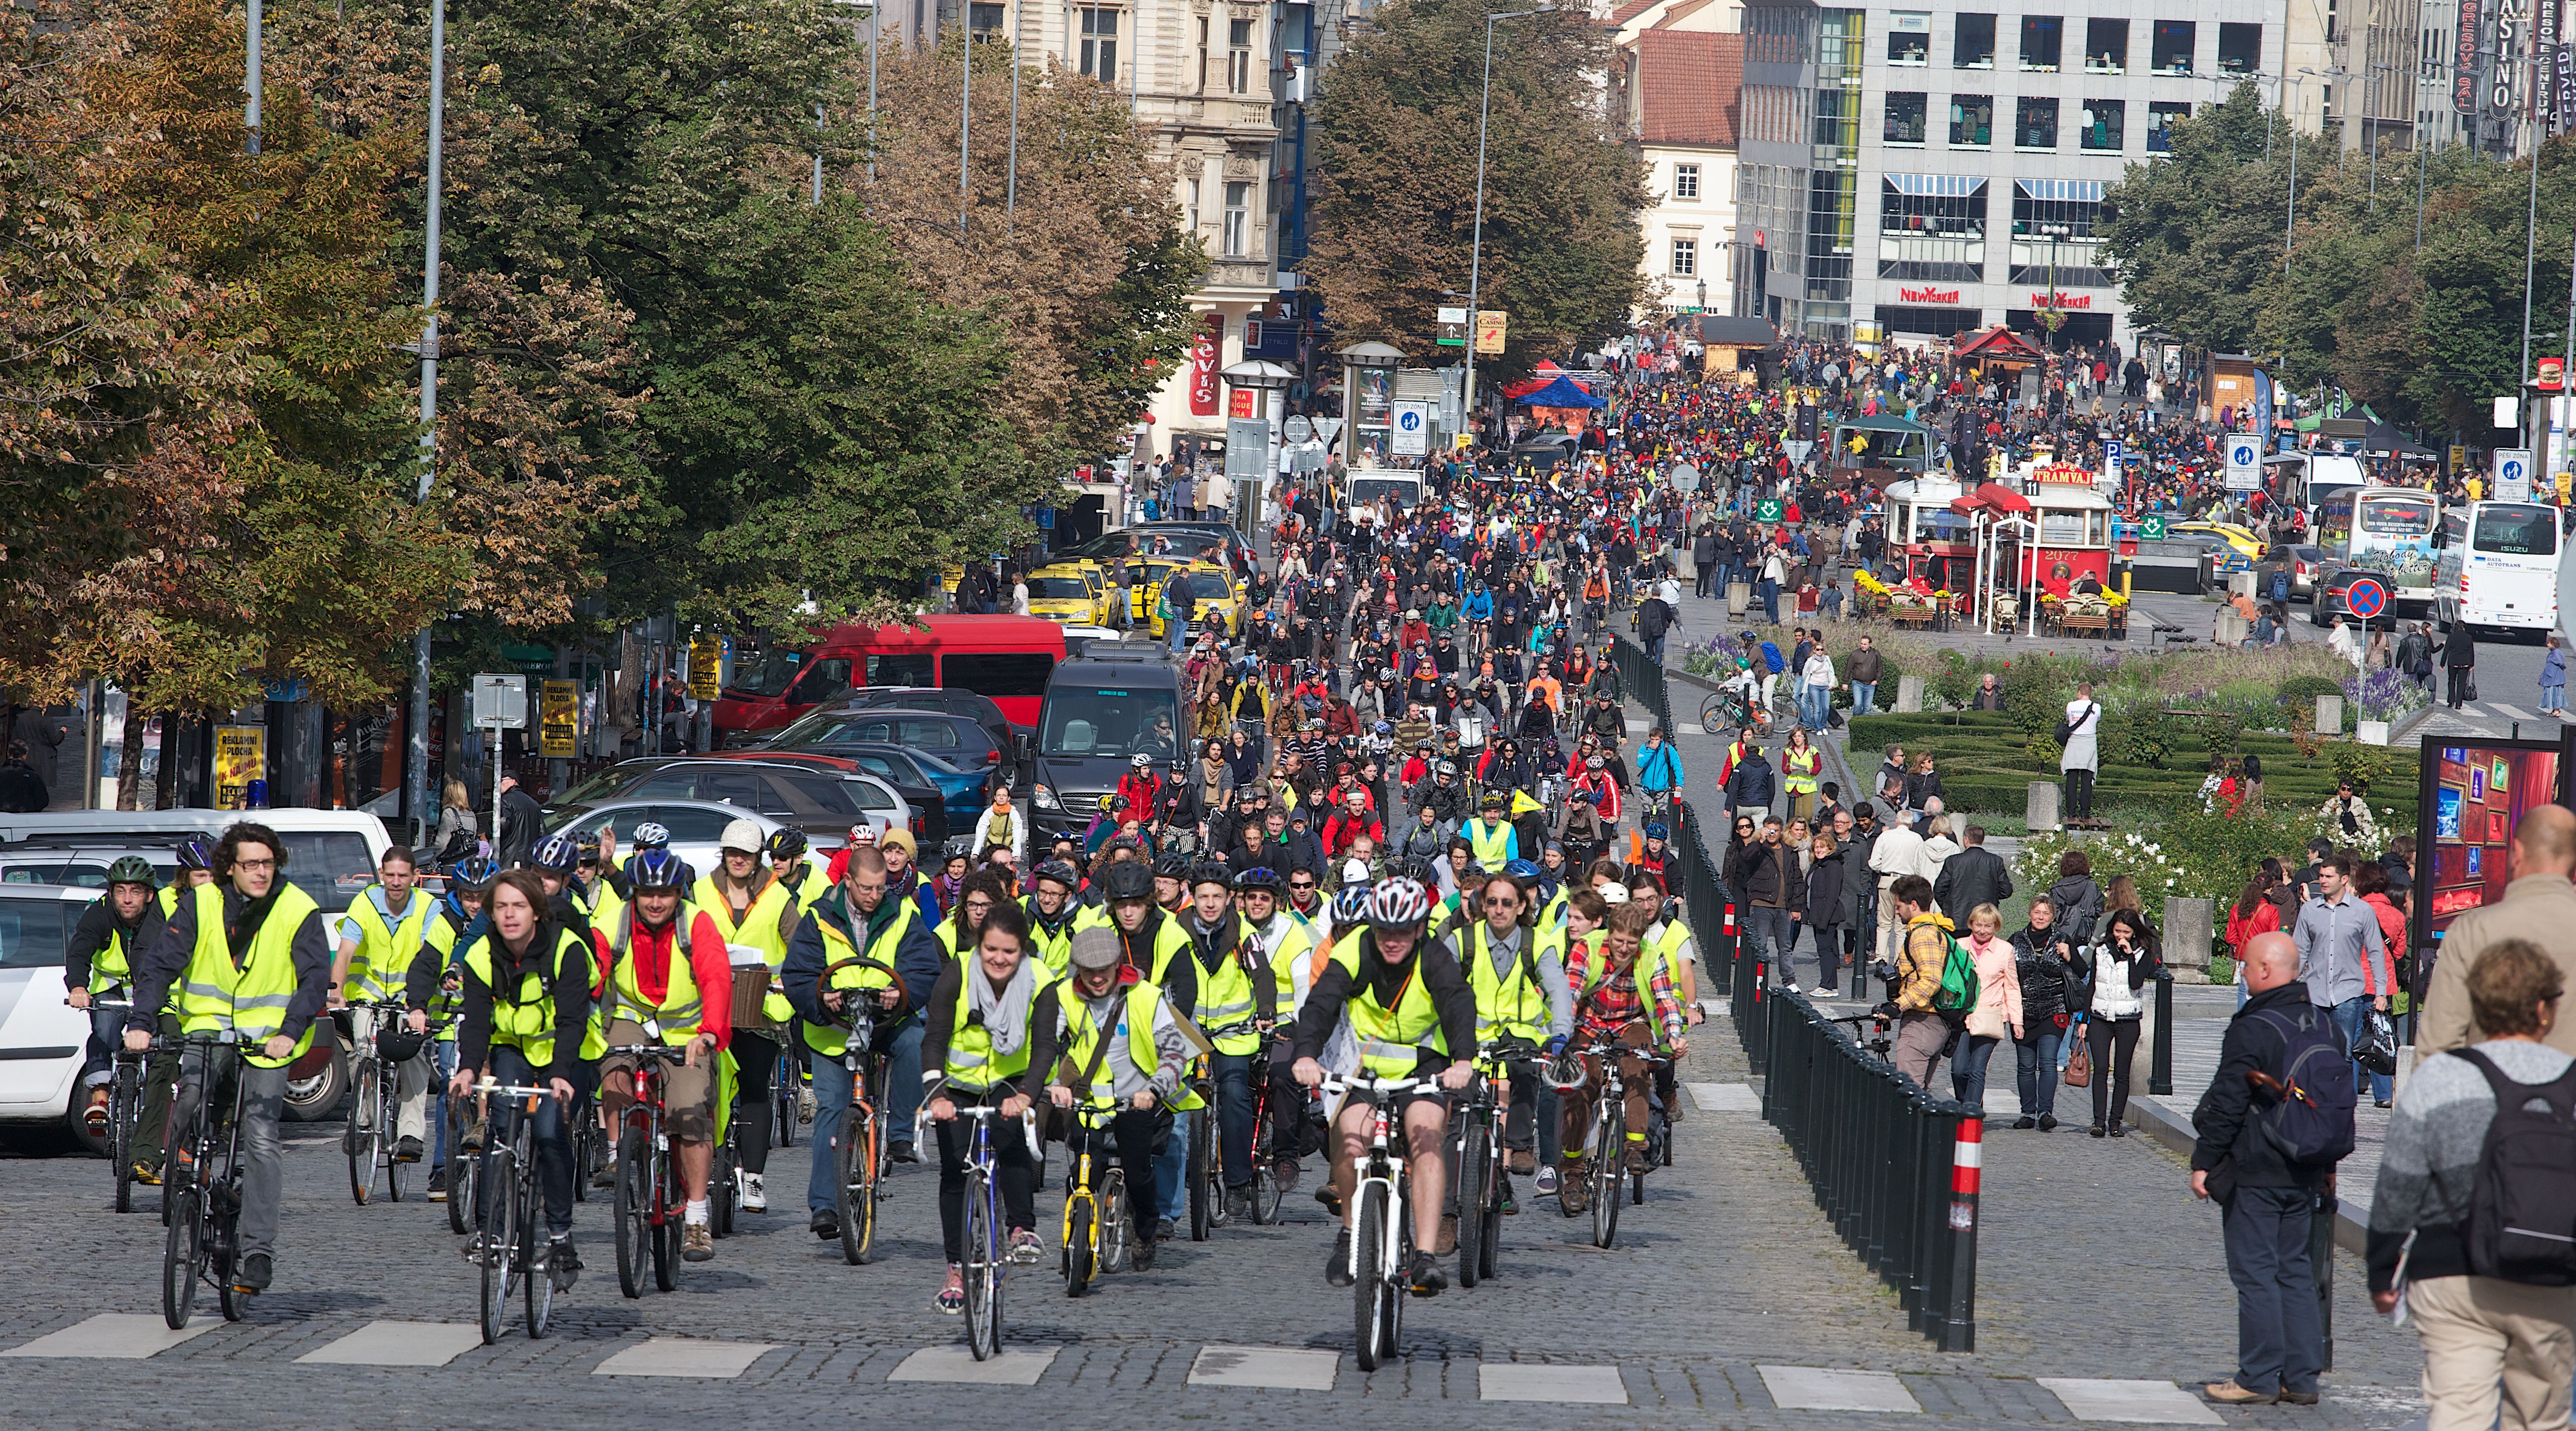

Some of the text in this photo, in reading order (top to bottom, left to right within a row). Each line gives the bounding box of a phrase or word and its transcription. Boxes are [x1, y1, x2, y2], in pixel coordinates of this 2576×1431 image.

[2108, 444, 2118, 457] P
[2034, 471, 2091, 485] TRAMVAJ
[2026, 482, 2037, 495] 11
[2045, 550, 2079, 561] 2077
[552, 703, 573, 719] NÁJMU
[222, 735, 257, 745] REKLAMNÍ
[227, 747, 252, 756] PLOCHA
[222, 757, 257, 782] K NÁJMU
[1546, 761, 1559, 769] GAP
